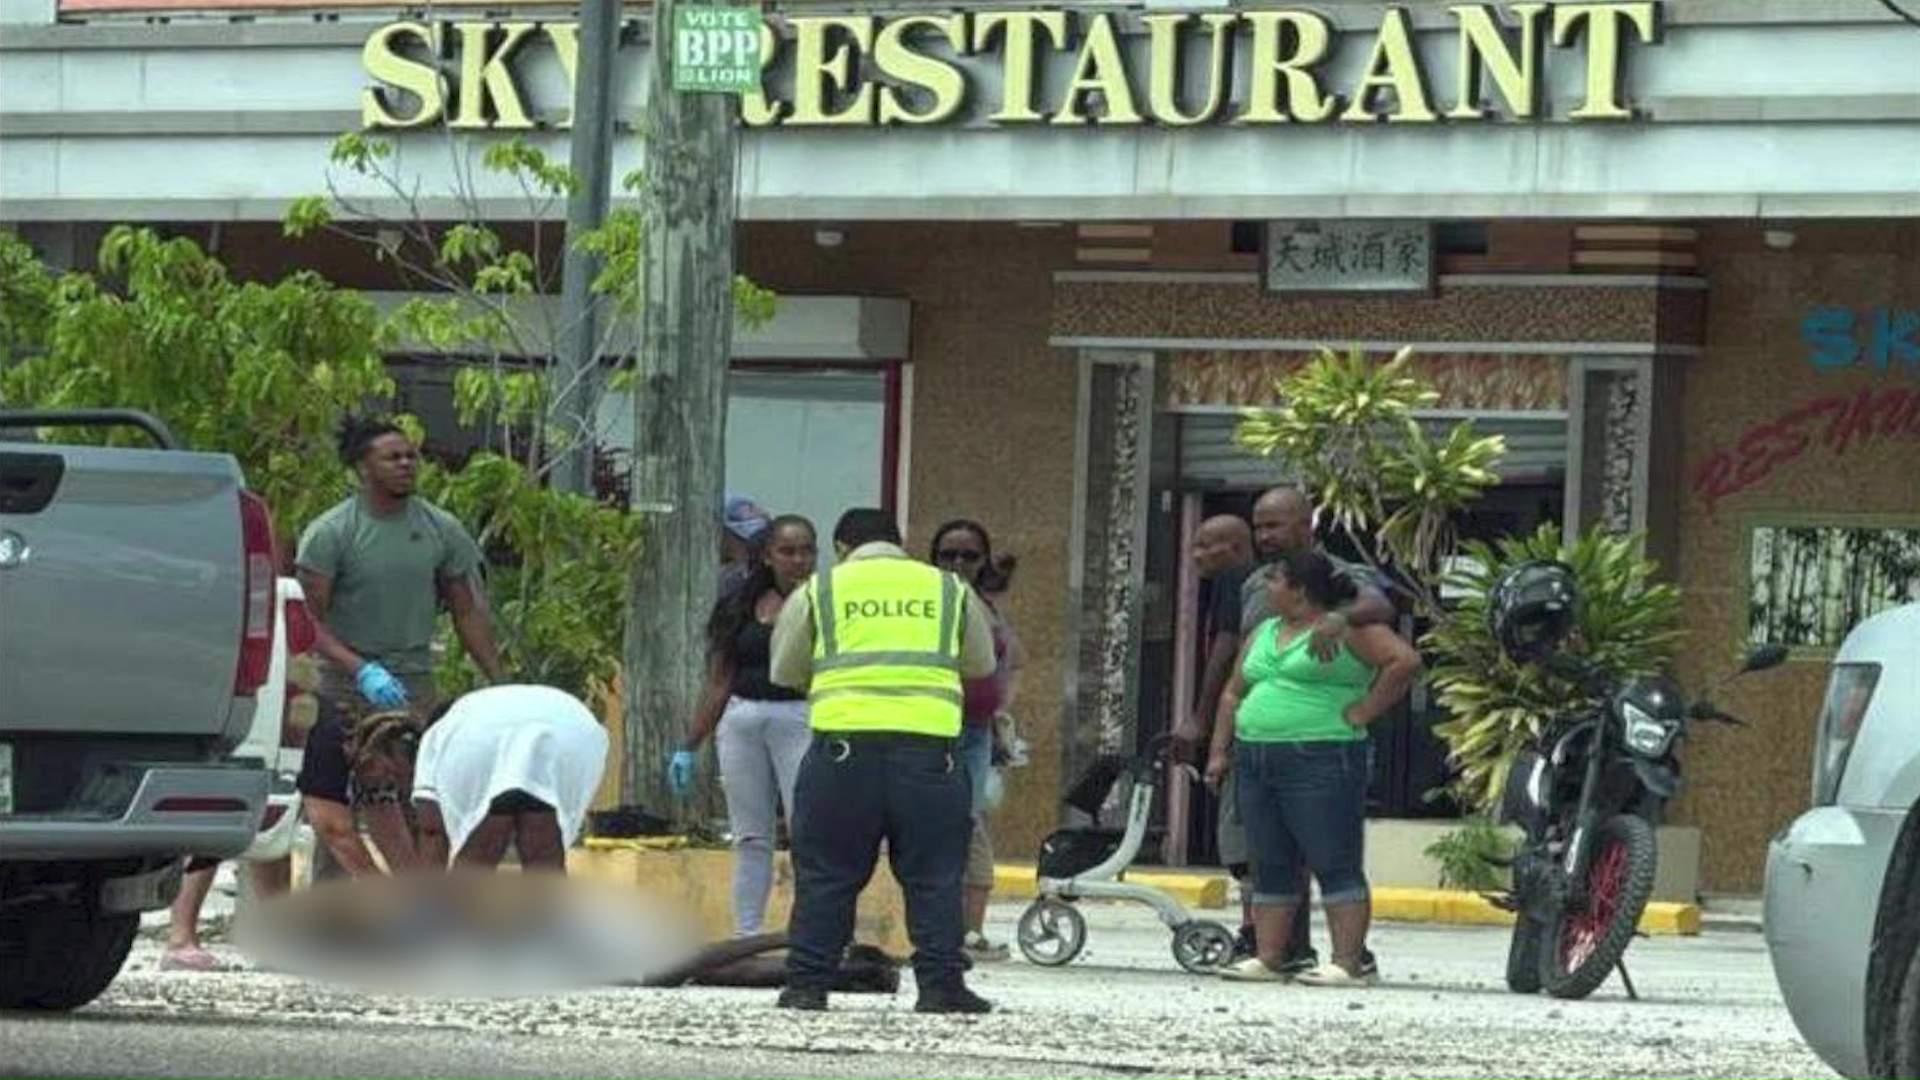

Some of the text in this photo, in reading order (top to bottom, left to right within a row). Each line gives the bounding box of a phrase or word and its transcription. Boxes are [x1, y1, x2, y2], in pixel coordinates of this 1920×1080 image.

[685, 10, 749, 27] VOTE
[679, 29, 759, 66] BPP
[844, 598, 937, 620] POLICE
